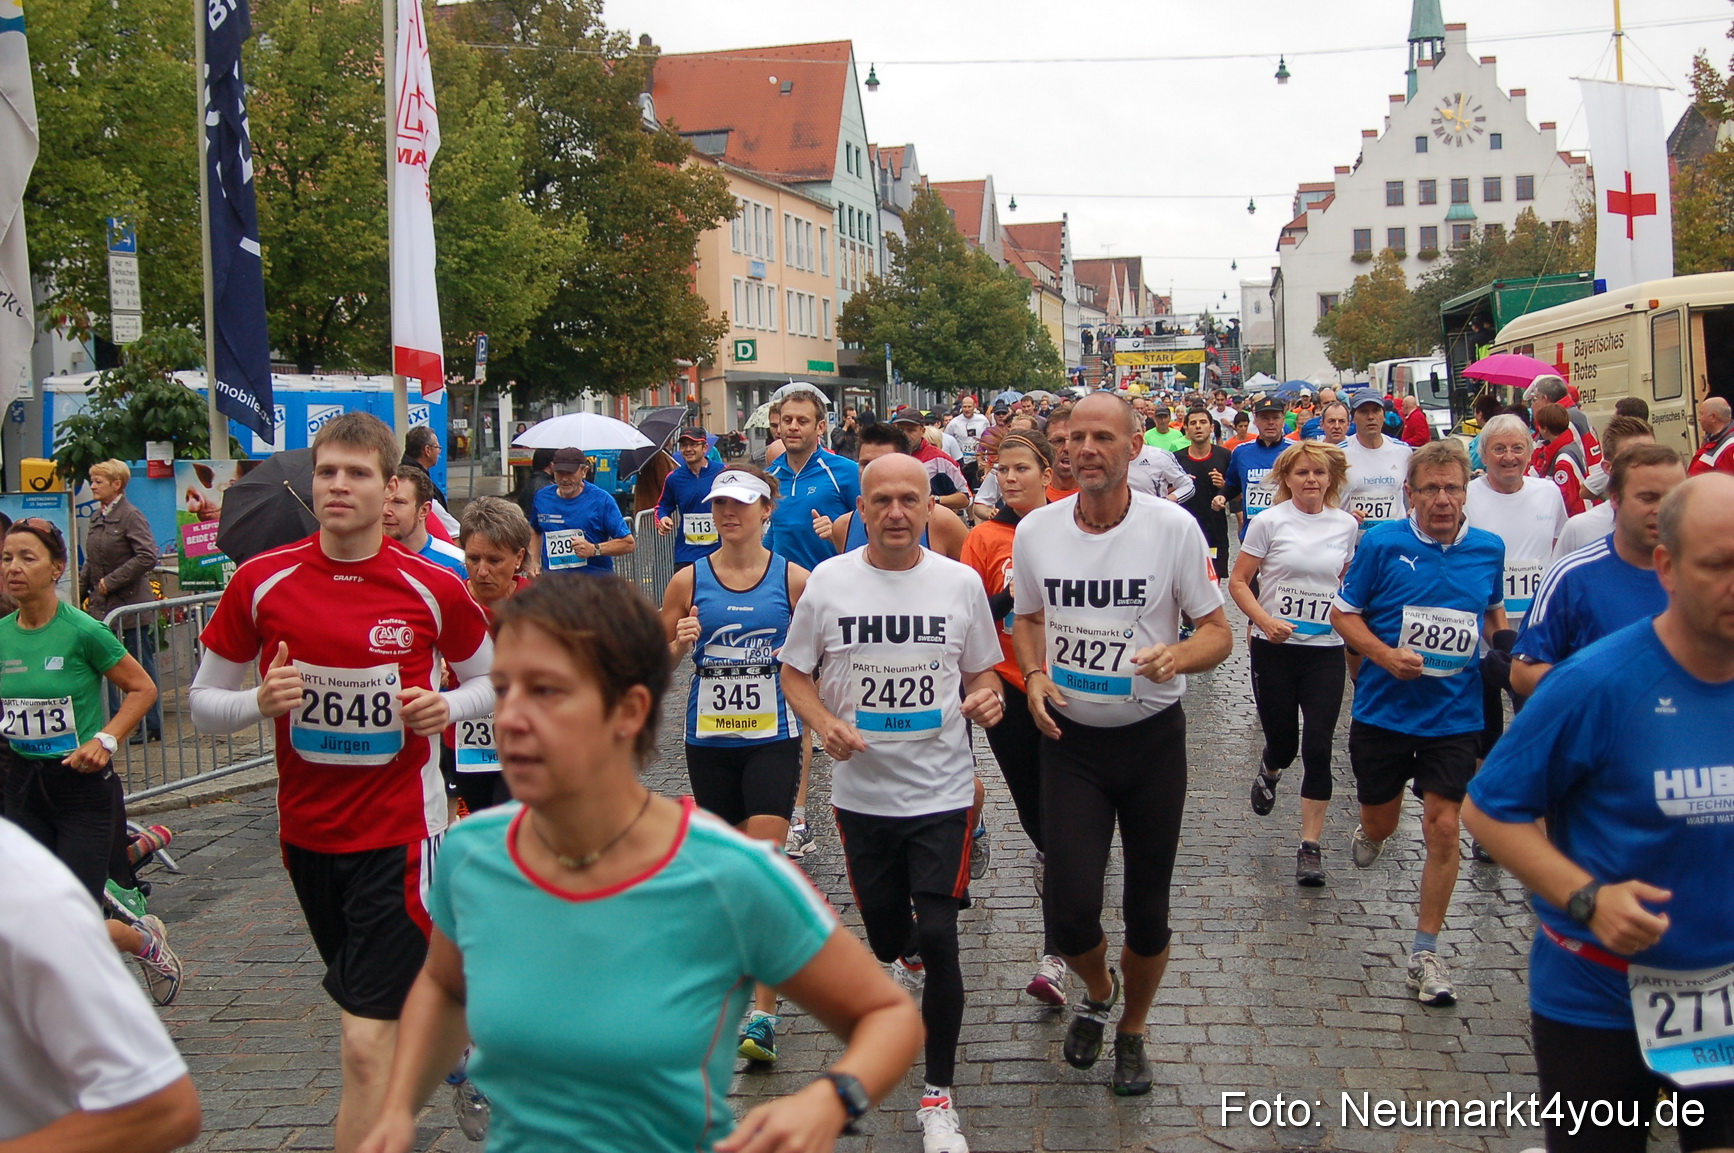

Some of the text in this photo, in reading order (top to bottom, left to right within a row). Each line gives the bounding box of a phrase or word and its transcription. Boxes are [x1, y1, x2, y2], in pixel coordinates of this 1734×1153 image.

[737, 342, 753, 359] D
[1574, 331, 1625, 360] Bayerisches
[1144, 354, 1174, 362] START
[1574, 362, 1597, 381] Rotes
[1651, 411, 1681, 425] Bayerisches
[1364, 476, 1395, 485] heinloth
[1249, 491, 1272, 506] 276
[1355, 502, 1392, 518] 2267
[690, 521, 711, 533] 113
[550, 539, 573, 555] 239
[1277, 585, 1328, 598] PARTL Neumarkt
[1505, 573, 1540, 595] 116
[1044, 578, 1147, 608] THULE
[1279, 596, 1332, 621] 3117
[1405, 611, 1465, 625] PARTL Neumarkt
[838, 615, 946, 645] THULE
[1050, 620, 1120, 637] PARTL Neumarkt
[917, 635, 943, 643] SWEDEN
[1407, 622, 1472, 653] 2820
[1055, 635, 1127, 672] 2427
[1421, 655, 1453, 668] ohann
[853, 662, 927, 673] PARTL Neumarkt
[300, 672, 382, 689] ARTL Neumarkt
[1067, 674, 1108, 692] Richard
[712, 684, 761, 711] 345
[861, 675, 935, 708] 2428
[301, 688, 393, 728] 2648
[4, 708, 68, 736] 2113
[716, 718, 757, 729] Melanie
[885, 717, 912, 729] Alex
[320, 735, 371, 754] Jürgen
[1688, 799, 1734, 811] TECHN
[1686, 815, 1714, 825] WASTE
